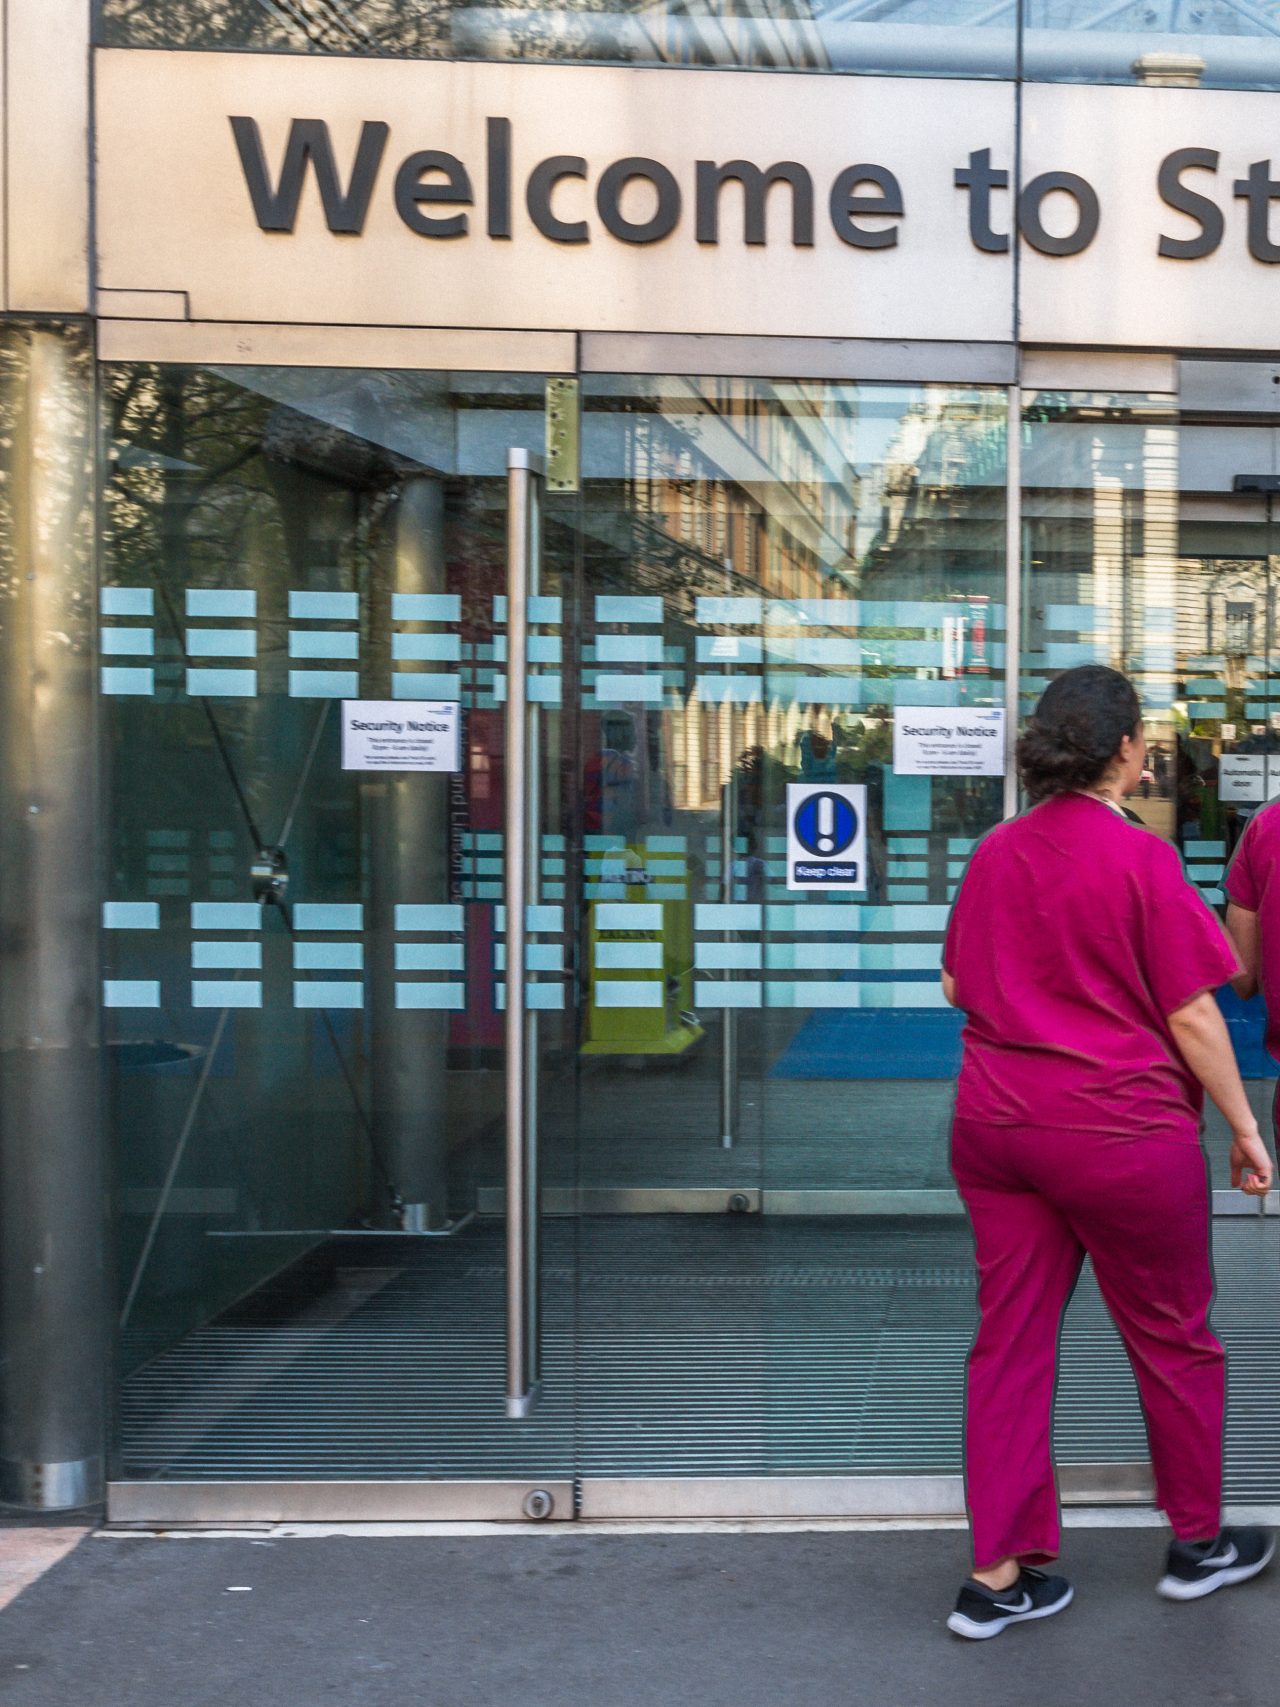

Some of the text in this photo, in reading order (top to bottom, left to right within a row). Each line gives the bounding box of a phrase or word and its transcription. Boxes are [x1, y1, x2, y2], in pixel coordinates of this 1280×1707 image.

[229, 115, 905, 250] Welcome
[953, 147, 1101, 257] to
[350, 720, 450, 734] Security Notice
[902, 725, 998, 739] Security Notice
[795, 866, 857, 879] Keep clear
